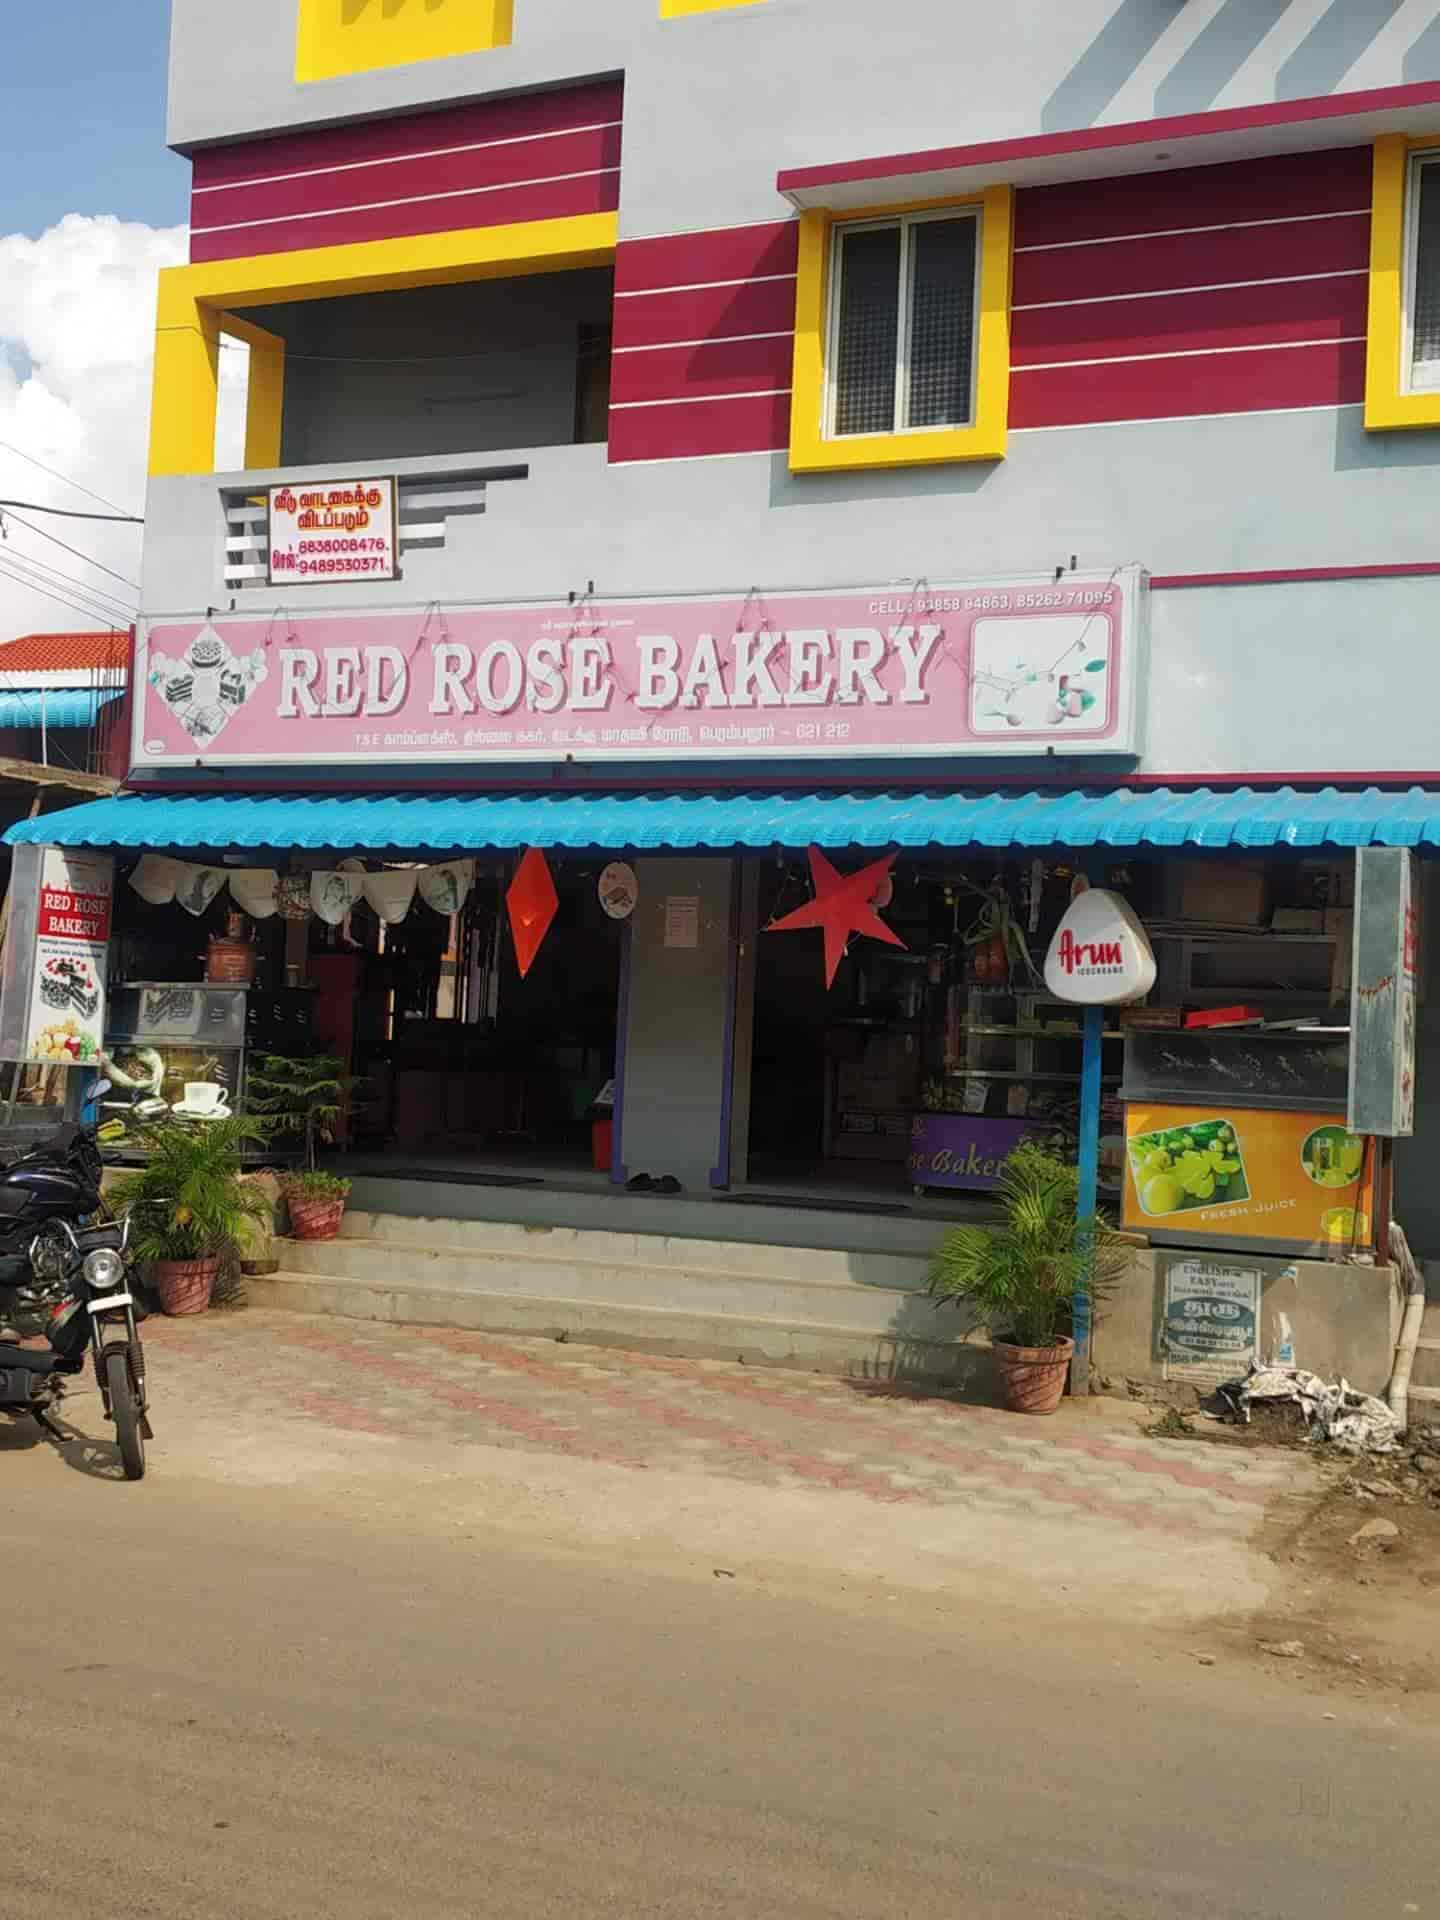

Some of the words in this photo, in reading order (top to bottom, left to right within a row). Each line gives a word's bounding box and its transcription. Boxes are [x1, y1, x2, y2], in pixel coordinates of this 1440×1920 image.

[274, 488, 297, 514] வீடு
[299, 484, 382, 506] வாடகைக்கு
[297, 506, 369, 532] விடப்படும்
[277, 645, 410, 718] RED
[429, 636, 615, 717] ROSE
[636, 623, 946, 711] BAKERY
[44, 893, 72, 911] RED
[74, 896, 105, 914] ROSE
[48, 915, 98, 936] BAKERY
[1057, 929, 1123, 975] Arun
[931, 1142, 1009, 1177] Baker
